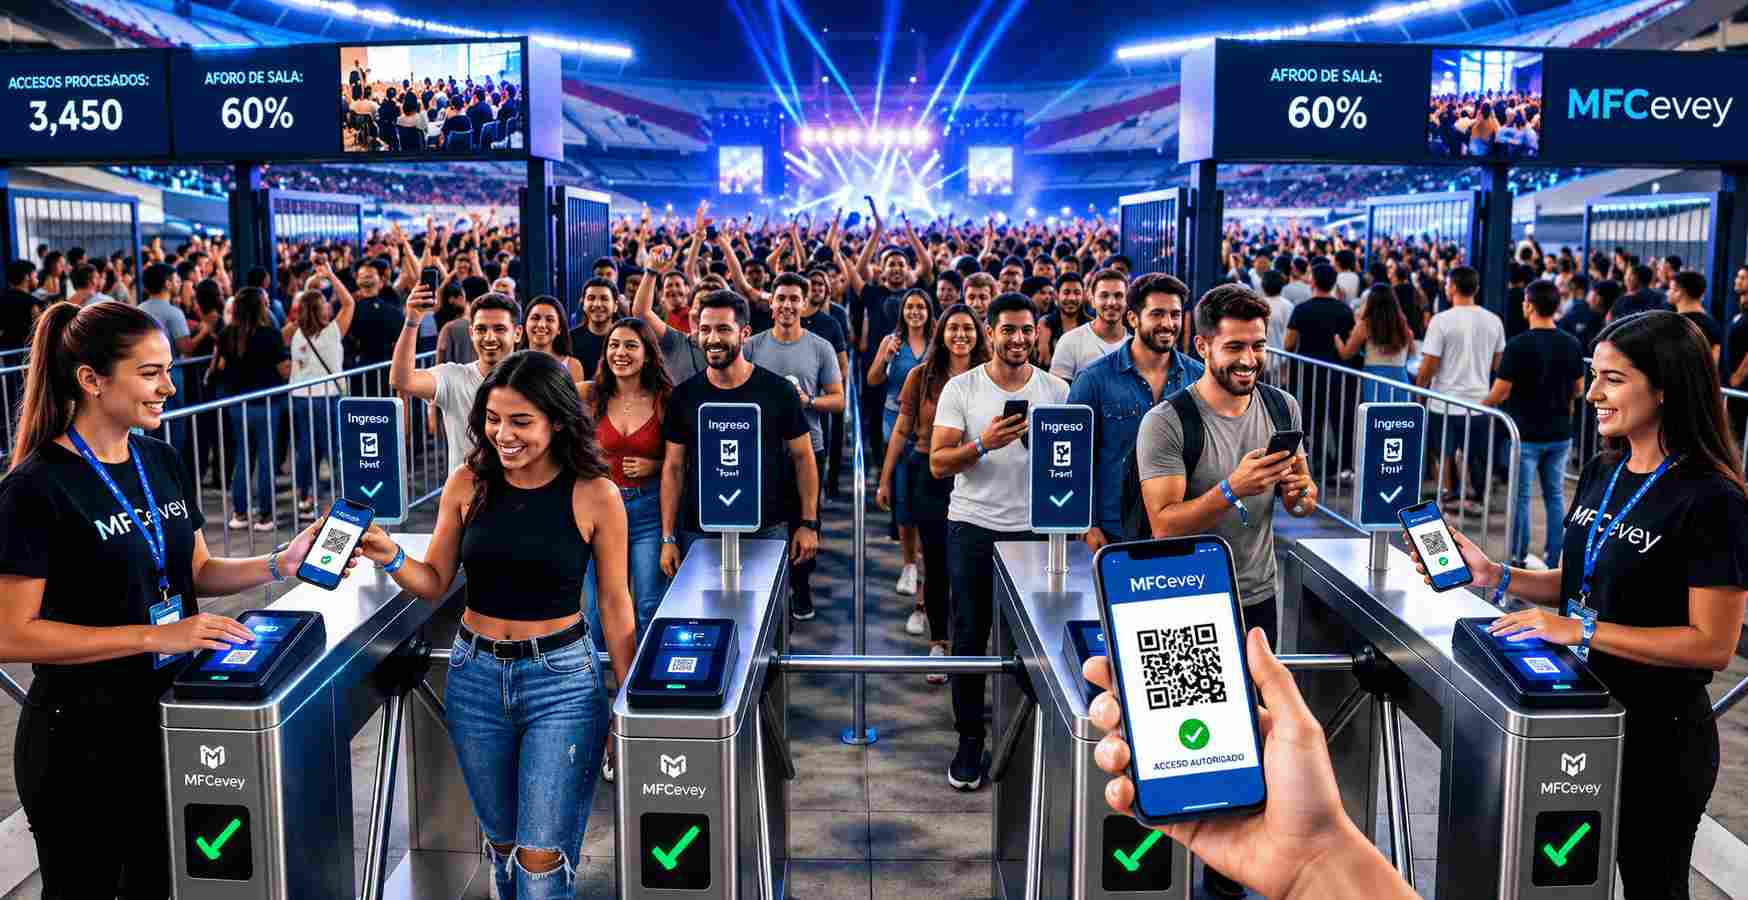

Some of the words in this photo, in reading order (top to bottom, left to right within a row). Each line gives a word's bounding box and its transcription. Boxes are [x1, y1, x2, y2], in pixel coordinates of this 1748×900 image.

[8, 76, 62, 89] ACCESOS
[65, 73, 150, 88] PROCESADOS:
[204, 71, 246, 85] AFORO
[248, 71, 265, 84] DE
[267, 70, 304, 83] SALA:
[1270, 68, 1318, 82] AFROO
[1320, 68, 1339, 82] DE
[1342, 69, 1382, 83] SALA:
[221, 96, 294, 129] 60%
[1288, 95, 1367, 129] 60%
[1567, 88, 1733, 128] MFCevey
[29, 98, 123, 137] 3,450
[347, 412, 389, 426] Ingreso
[708, 419, 750, 432] Ingreso
[1041, 420, 1084, 433] Ingreso
[1374, 418, 1415, 431] Ingreso
[1130, 574, 1205, 593] MFCevey
[1153, 759, 1189, 770] ACCESO
[184, 774, 246, 790] MFCevey
[1540, 782, 1602, 797] MFCevey
[642, 783, 706, 798] MFCevey
